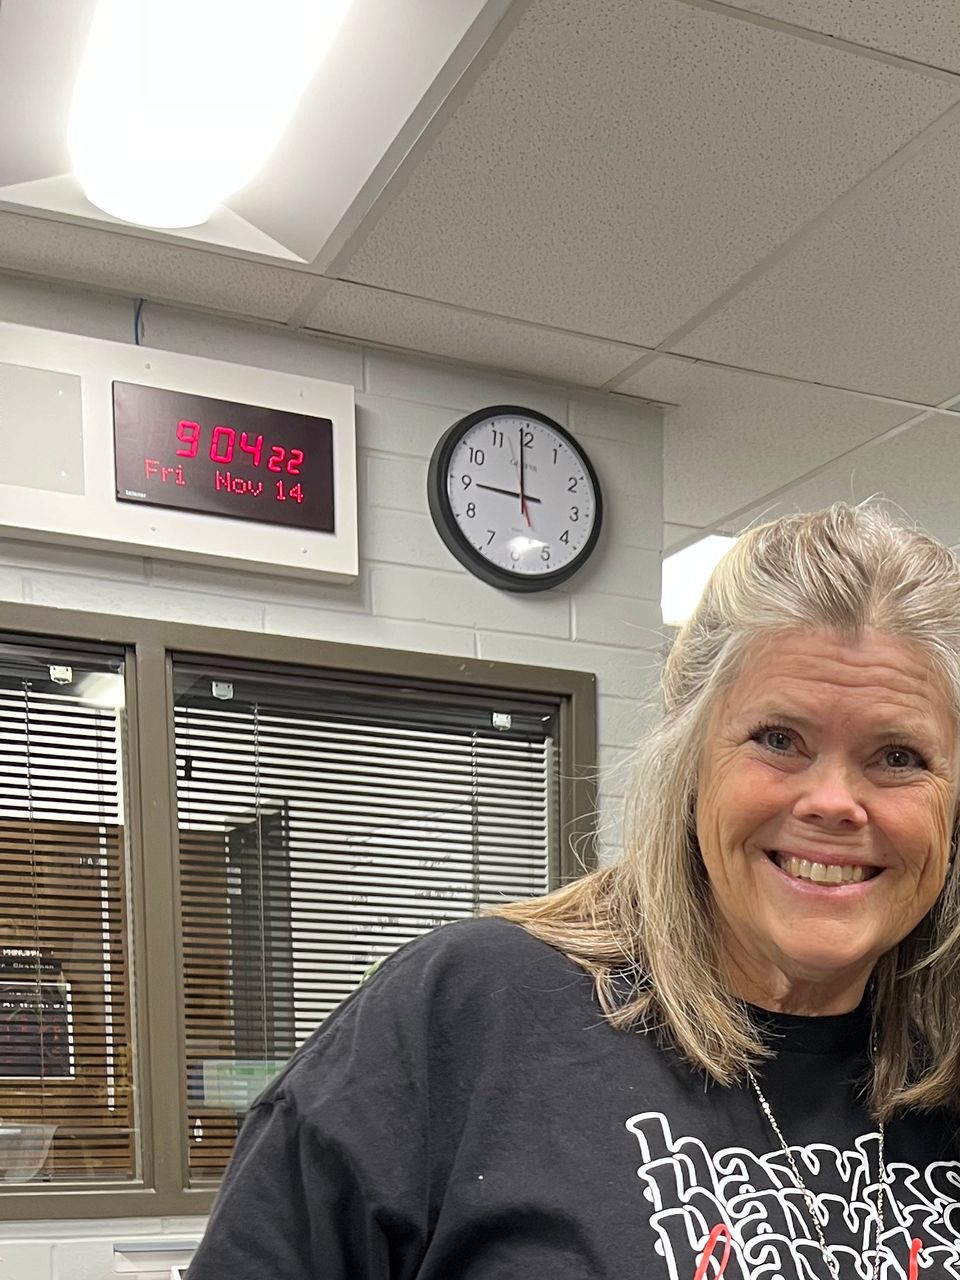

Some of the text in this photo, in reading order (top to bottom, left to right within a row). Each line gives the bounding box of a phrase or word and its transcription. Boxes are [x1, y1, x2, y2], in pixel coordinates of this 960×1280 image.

[491, 430, 504, 448] 11
[469, 447, 485, 466] 10
[145, 458, 304, 503] Fri Nov 14
[461, 474, 472, 490] 9
[567, 477, 578, 493] 2
[466, 502, 476, 518] 8
[569, 506, 579, 522] 3
[487, 529, 496, 545] 7
[559, 530, 569, 545] 4
[540, 546, 551, 561] 5
